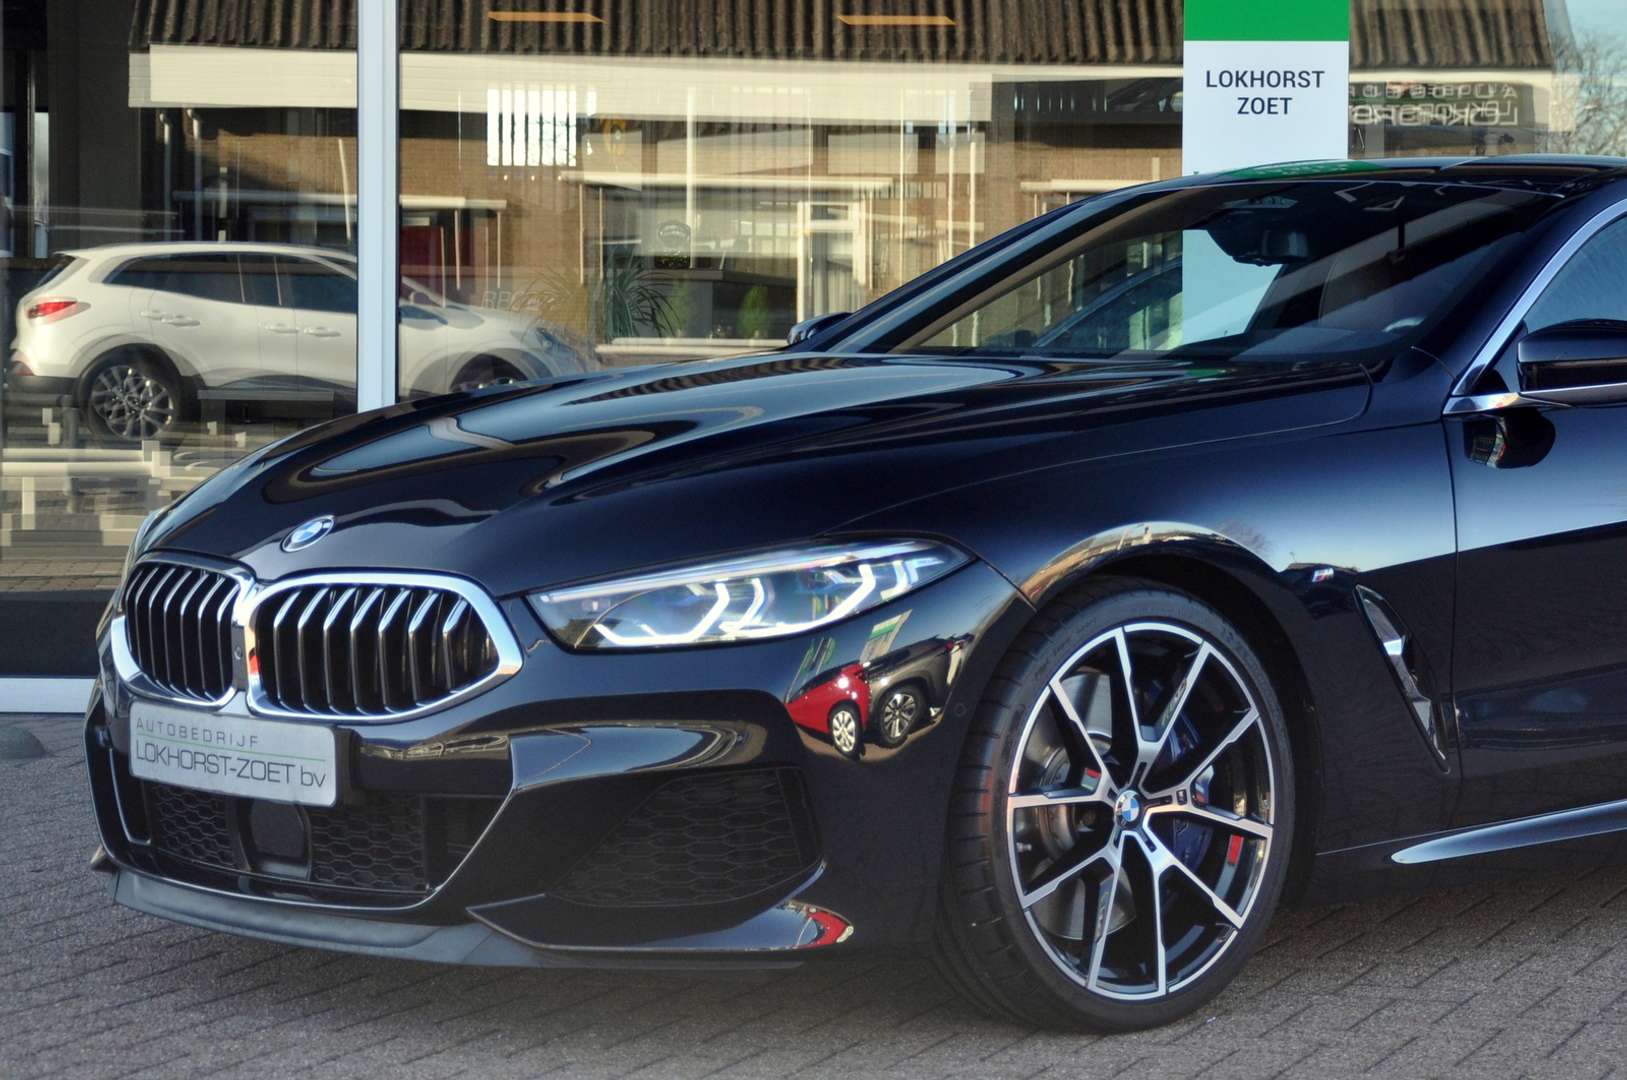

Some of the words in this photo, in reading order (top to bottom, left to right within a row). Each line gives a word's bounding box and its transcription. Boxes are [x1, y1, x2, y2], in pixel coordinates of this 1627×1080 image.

[1205, 70, 1325, 89] LOKHORST
[1237, 97, 1293, 115] ZOET
[136, 717, 260, 749] AUTOBEDRIJF
[136, 740, 296, 784] LOKHORST-ZOET
[300, 765, 326, 788] bv
